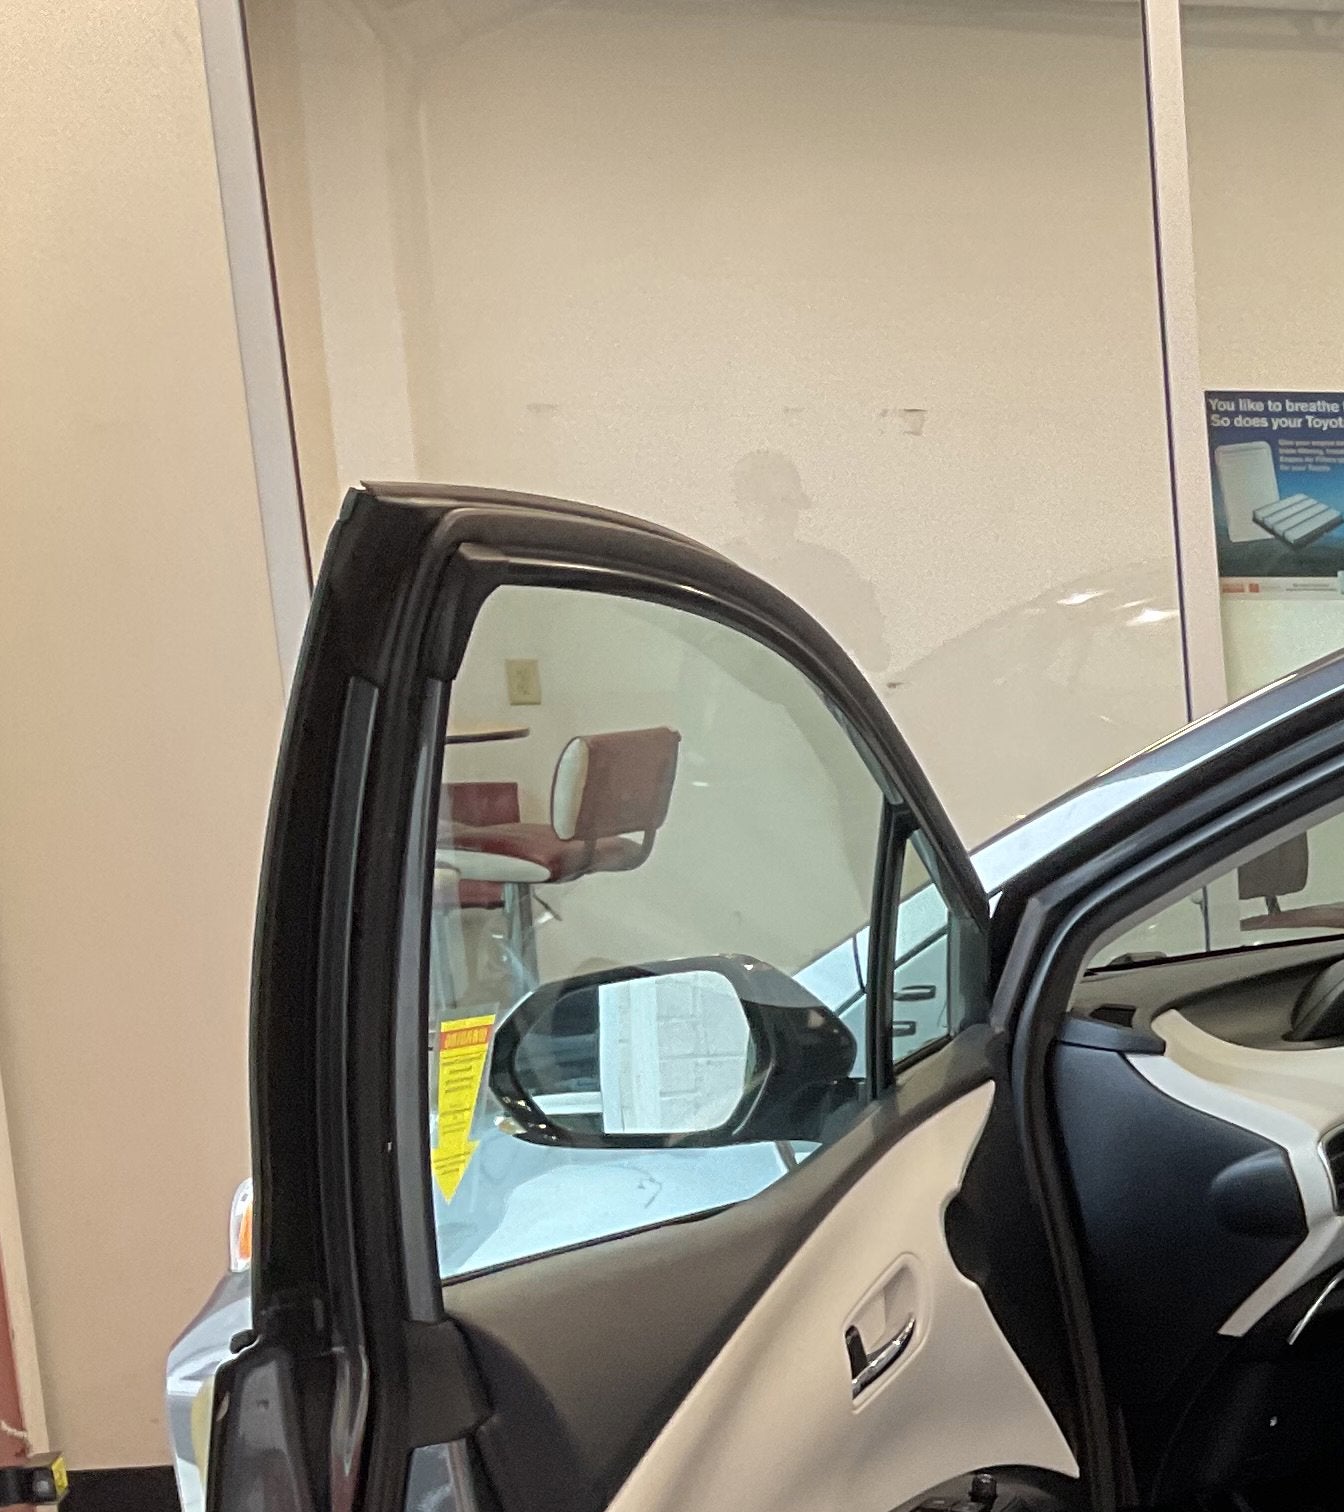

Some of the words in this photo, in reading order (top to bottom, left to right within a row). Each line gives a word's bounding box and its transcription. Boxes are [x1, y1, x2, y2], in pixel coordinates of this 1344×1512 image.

[1208, 398, 1235, 412] You
[1239, 399, 1264, 413] like
[1268, 400, 1282, 413] to
[1286, 399, 1340, 413] breathe
[1210, 413, 1231, 427] So
[1234, 414, 1268, 428] does
[1271, 416, 1303, 431] your
